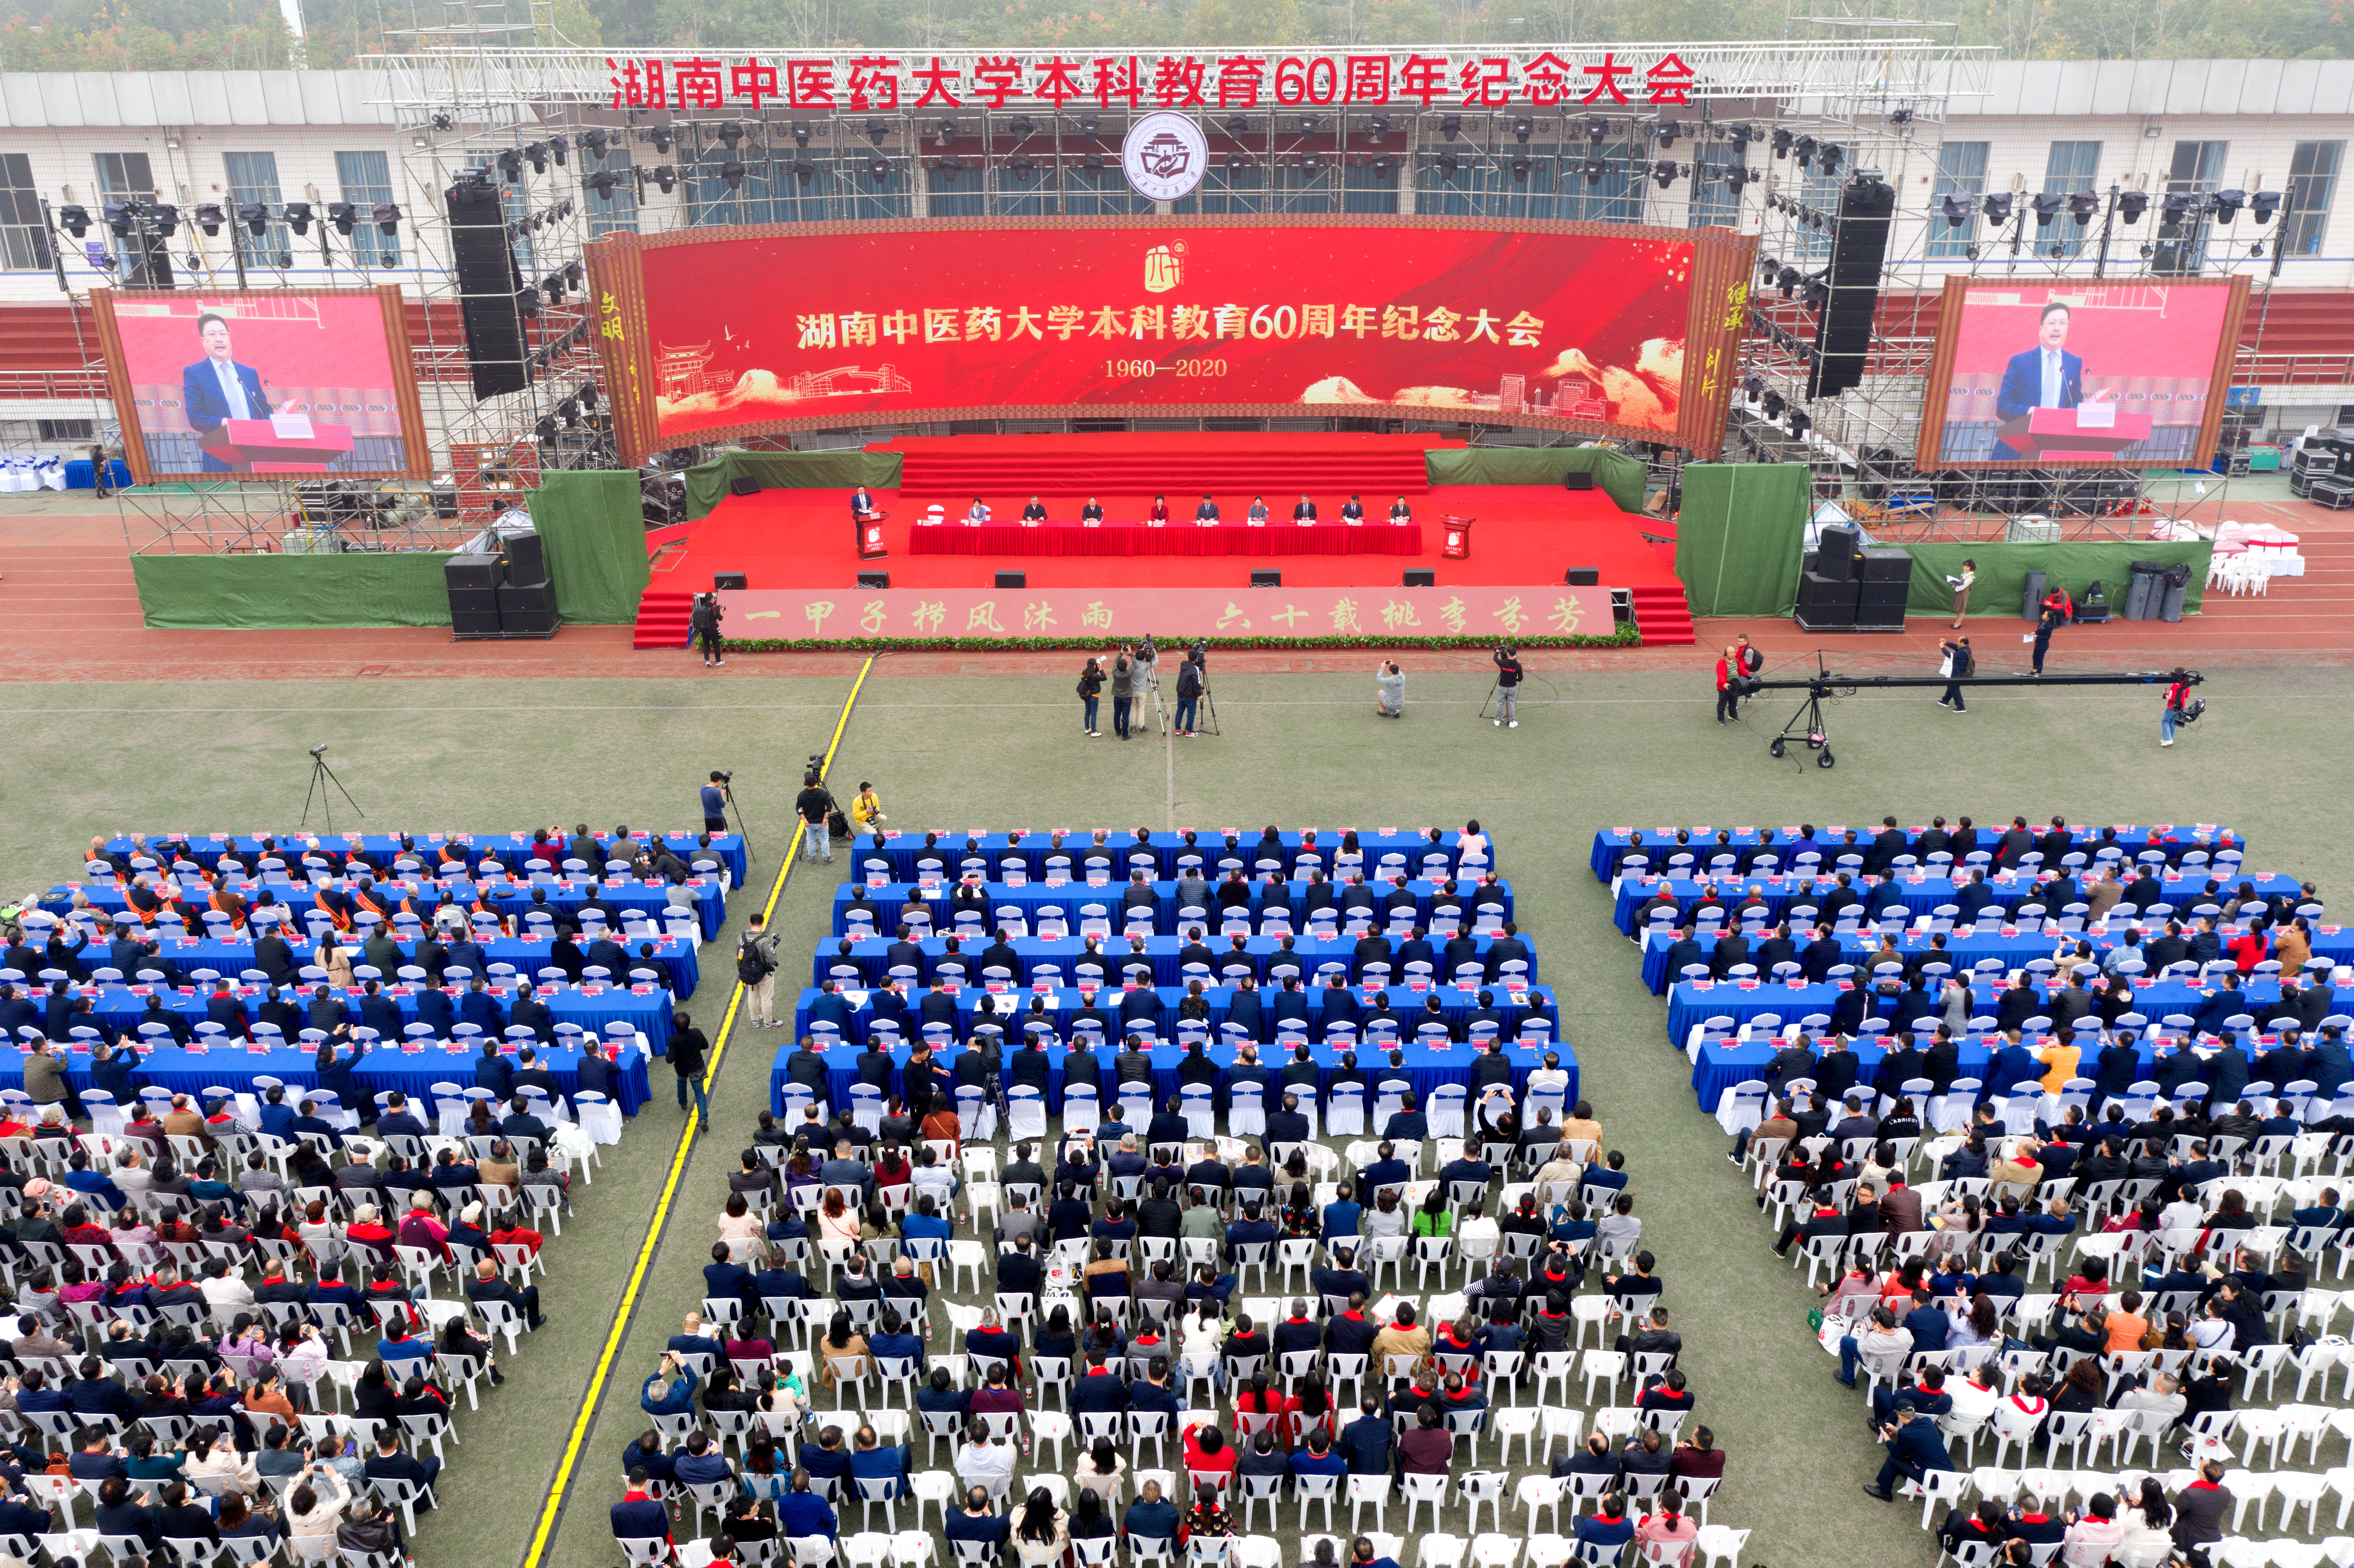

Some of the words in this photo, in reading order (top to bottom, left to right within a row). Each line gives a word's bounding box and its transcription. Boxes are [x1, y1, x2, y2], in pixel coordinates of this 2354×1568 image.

[608, 52, 1695, 112] 湖南中医药大学本科教育60周年纪念大会
[1135, 119, 1161, 140] UNIVERSITY
[1171, 120, 1191, 134] CHINESE
[1190, 134, 1201, 160] MEDICINE
[601, 291, 625, 342] 文明
[796, 303, 1544, 350] 湖南中医药大学本科教育60周年纪念大会
[745, 600, 1113, 635] 一甲子栉风沐雨
[1215, 595, 1586, 634] 六十载桃李芬芳
